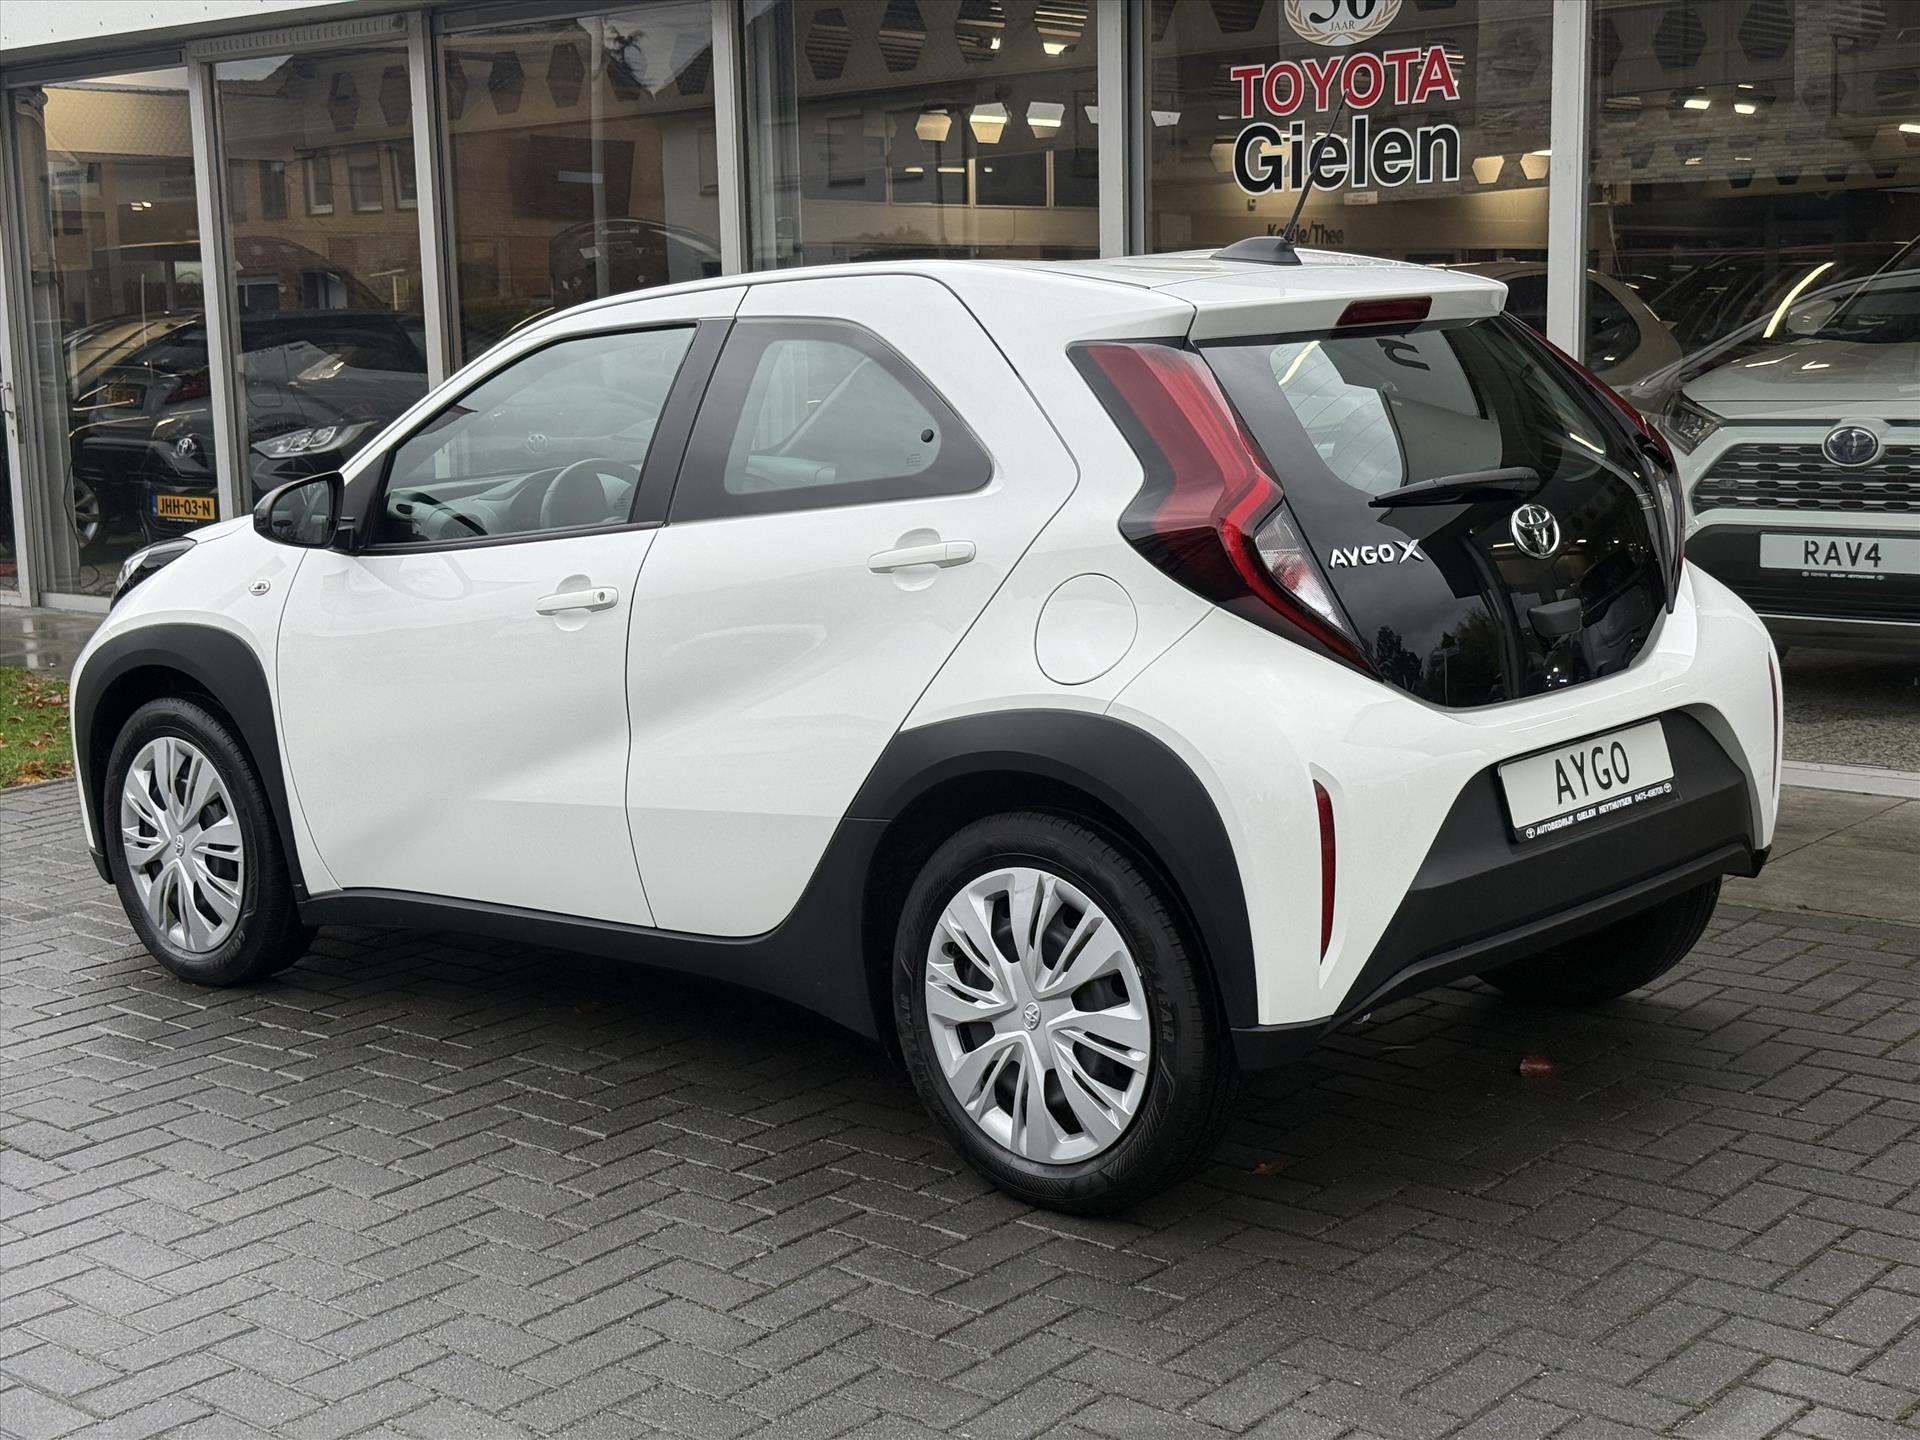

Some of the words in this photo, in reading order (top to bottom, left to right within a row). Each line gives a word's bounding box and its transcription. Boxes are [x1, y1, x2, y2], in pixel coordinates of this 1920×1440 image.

[1330, 20, 1355, 31] JAAR
[1230, 45, 1460, 119] TOYOTA
[1232, 115, 1460, 196] Gielen
[160, 498, 211, 516] JHH-03-N
[1329, 544, 1395, 569] AYGO
[1393, 539, 1424, 564] X
[1803, 540, 1882, 568] RAV4
[1555, 741, 1630, 805] AYGO
